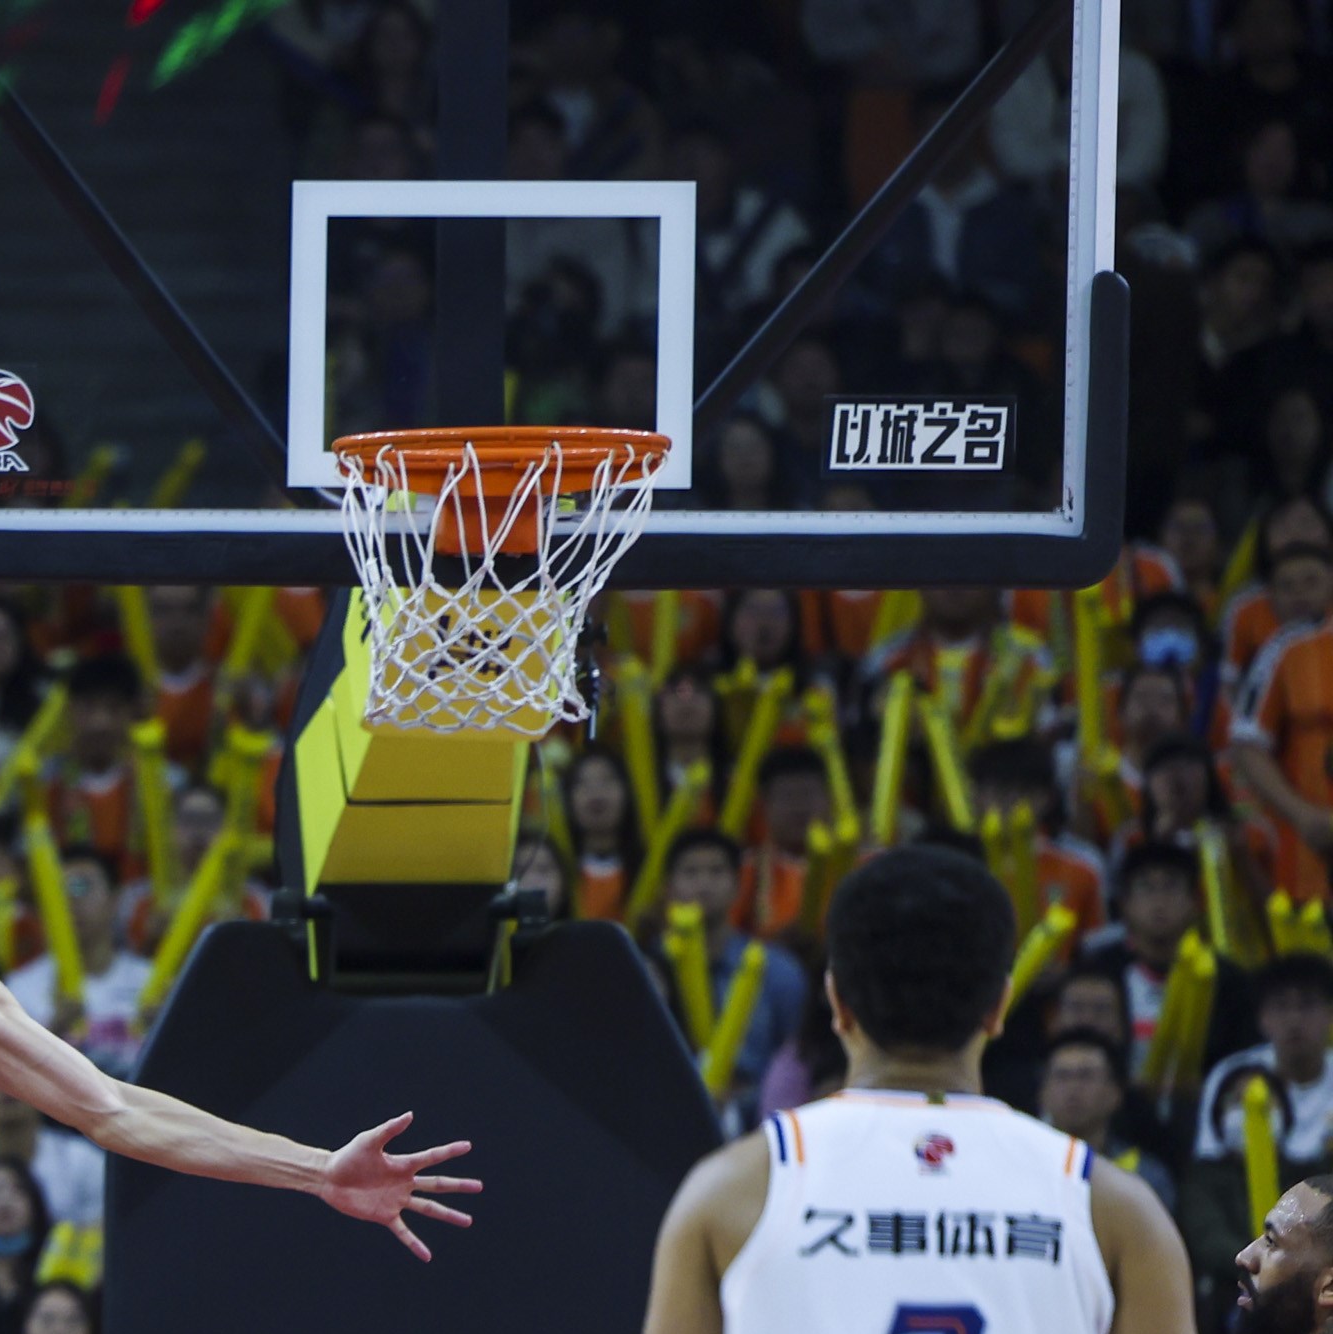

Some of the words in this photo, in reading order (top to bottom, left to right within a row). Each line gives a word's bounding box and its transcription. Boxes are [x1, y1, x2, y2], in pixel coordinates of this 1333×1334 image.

[830, 402, 1009, 470] 以城之名
[800, 1208, 1062, 1264] 久事体育
